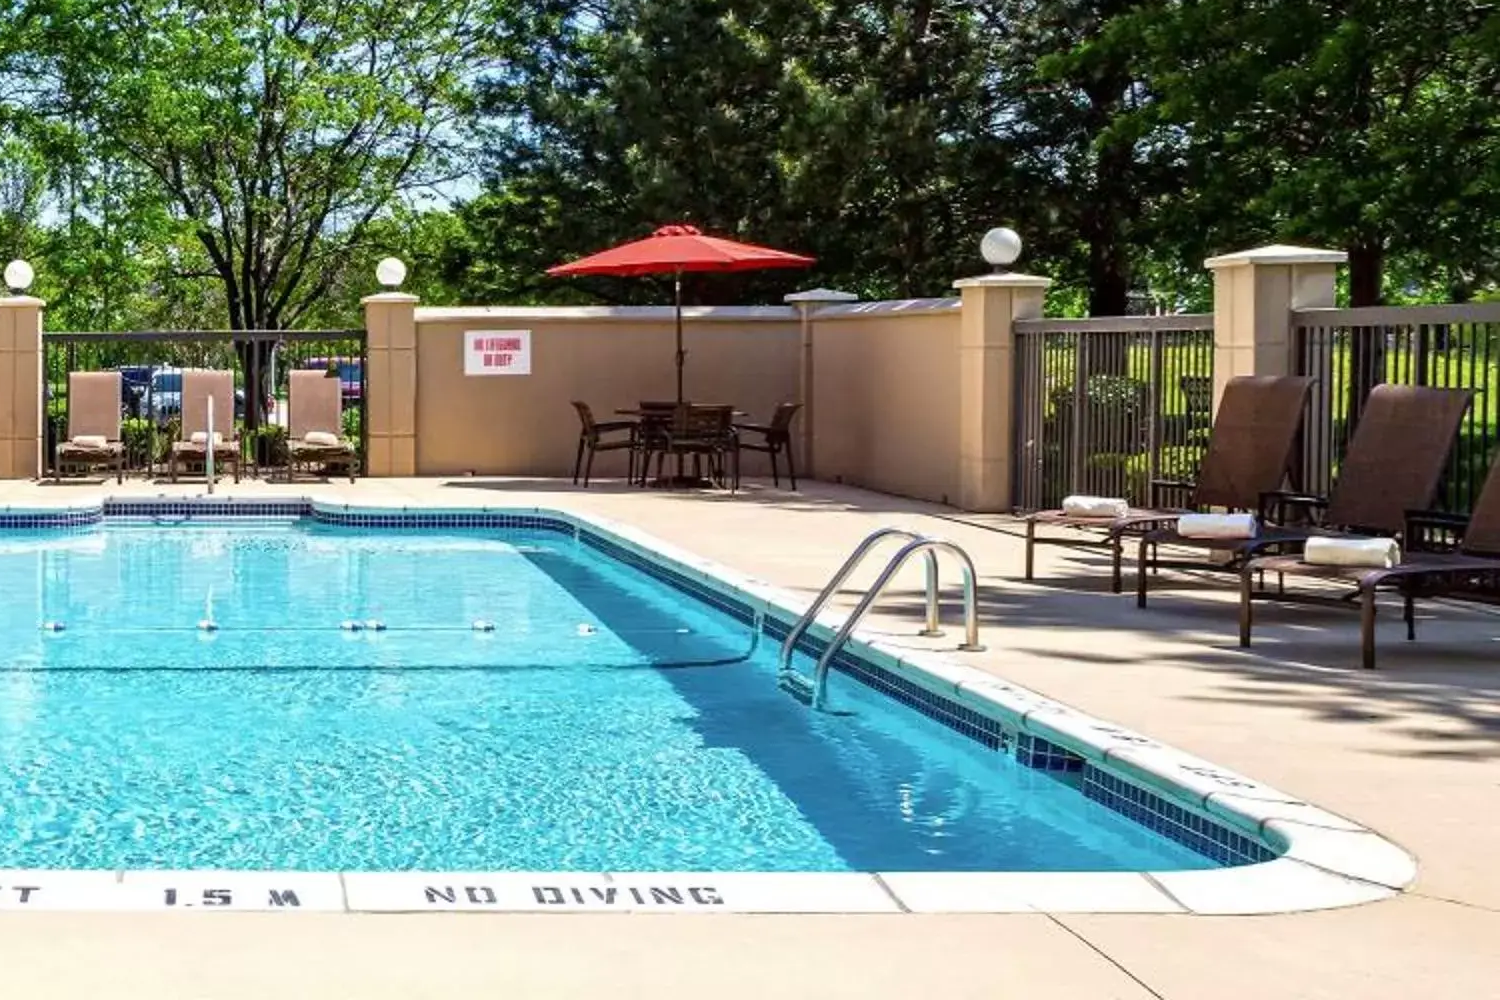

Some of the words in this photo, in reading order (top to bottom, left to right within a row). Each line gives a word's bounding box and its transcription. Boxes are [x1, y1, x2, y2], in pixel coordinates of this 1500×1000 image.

[164, 888, 232, 906] 1.5
[269, 889, 301, 906] M
[424, 886, 498, 904] NO
[532, 886, 725, 905] DIVING
